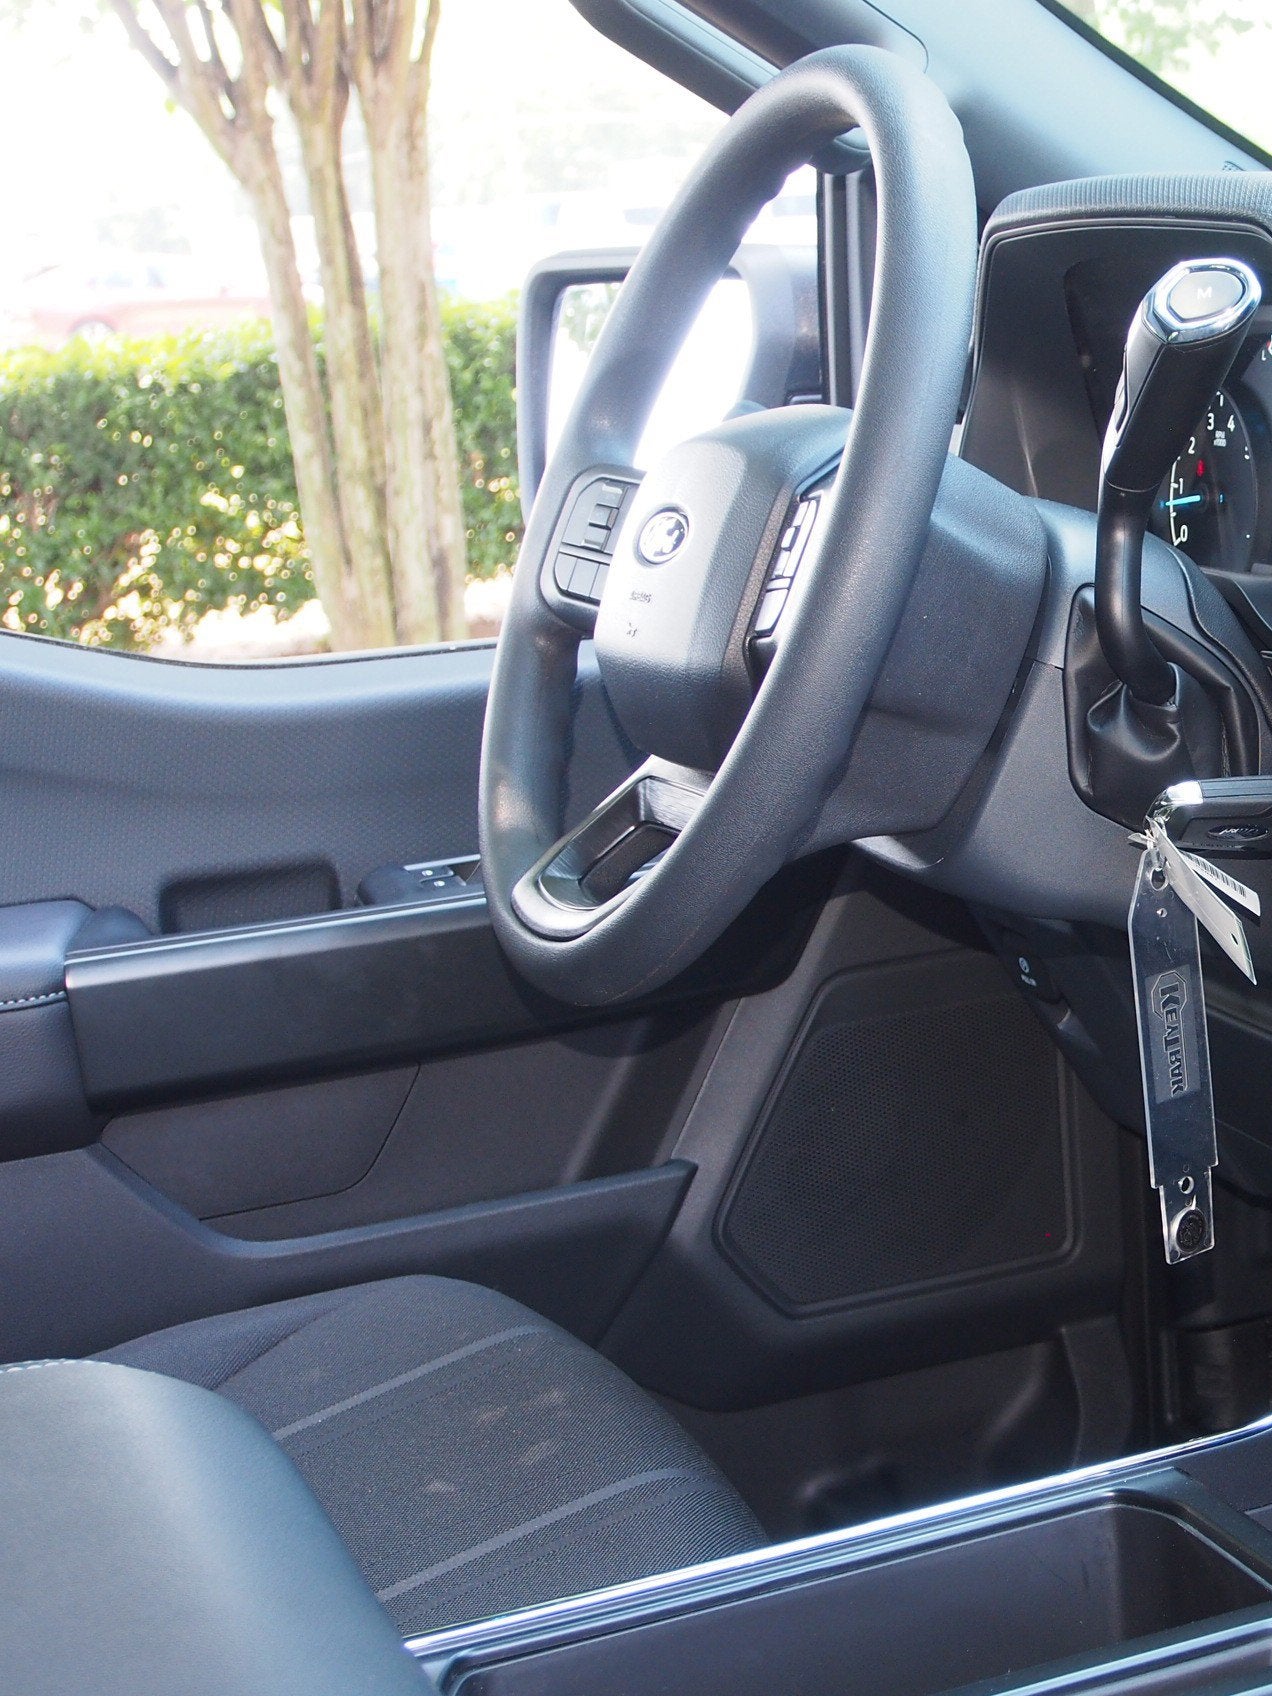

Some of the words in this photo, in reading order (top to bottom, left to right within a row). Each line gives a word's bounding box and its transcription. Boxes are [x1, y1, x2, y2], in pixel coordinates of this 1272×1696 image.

[1197, 286, 1213, 300] M
[1261, 350, 1266, 361] L
[1207, 412, 1214, 431] 3
[1227, 414, 1235, 432] 4
[1188, 436, 1195, 454] 2
[1179, 477, 1184, 495] 1
[1180, 525, 1188, 542] 0
